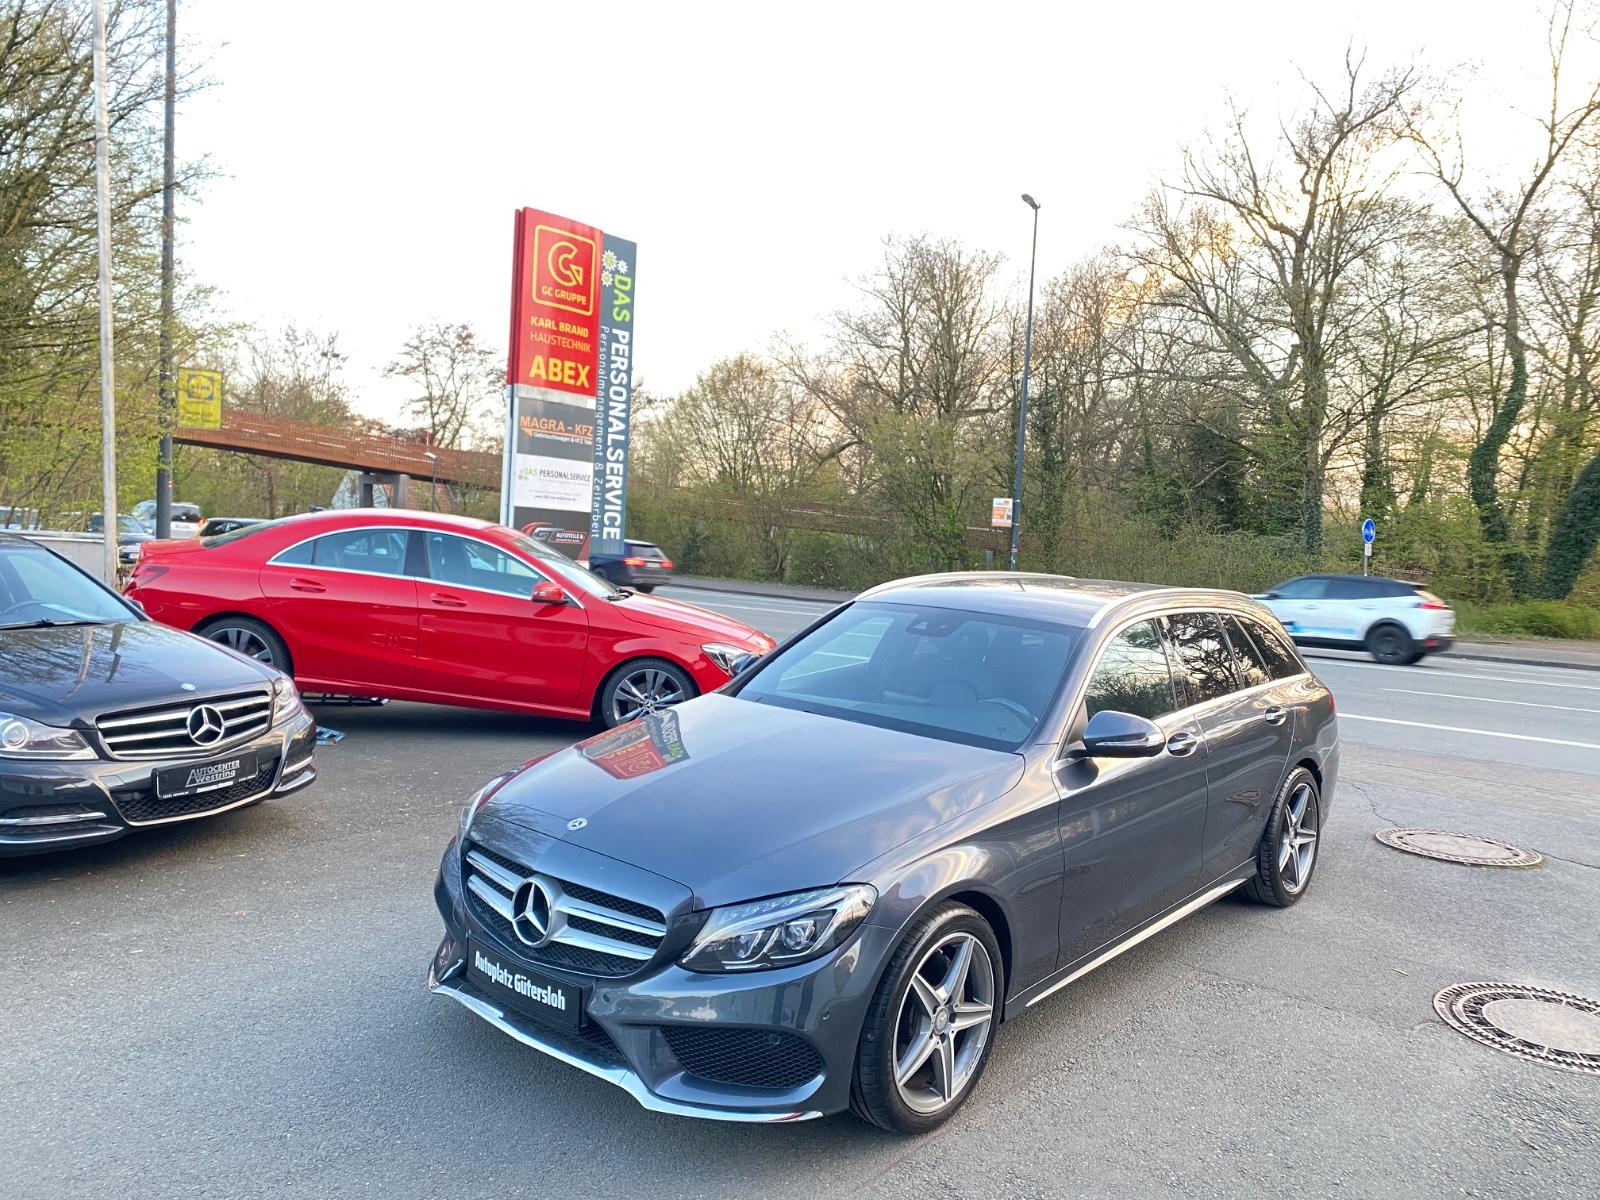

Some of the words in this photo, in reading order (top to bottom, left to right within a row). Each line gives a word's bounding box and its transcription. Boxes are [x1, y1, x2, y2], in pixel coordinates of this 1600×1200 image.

[541, 285, 553, 297] GC
[554, 288, 587, 305] GRUPPE
[612, 274, 632, 323] DAS
[530, 315, 557, 330] KARL
[559, 322, 589, 338] BRAND
[530, 331, 591, 353] HAUSTECHNIK
[529, 355, 591, 388] ABEX
[594, 325, 609, 457] Personalmanagement
[520, 415, 565, 432] MAGRA
[574, 423, 593, 437] KFZ
[602, 328, 630, 540] PERSONALSERVICE
[539, 469, 591, 483] PERSONALSERVICE
[594, 464, 604, 472] &
[591, 478, 604, 538] Zeitarbeit
[185, 760, 240, 787] AUTOCENTER
[196, 769, 236, 783] Westring
[475, 950, 514, 989] Autoplatz
[514, 973, 566, 1011] Gütersloh
